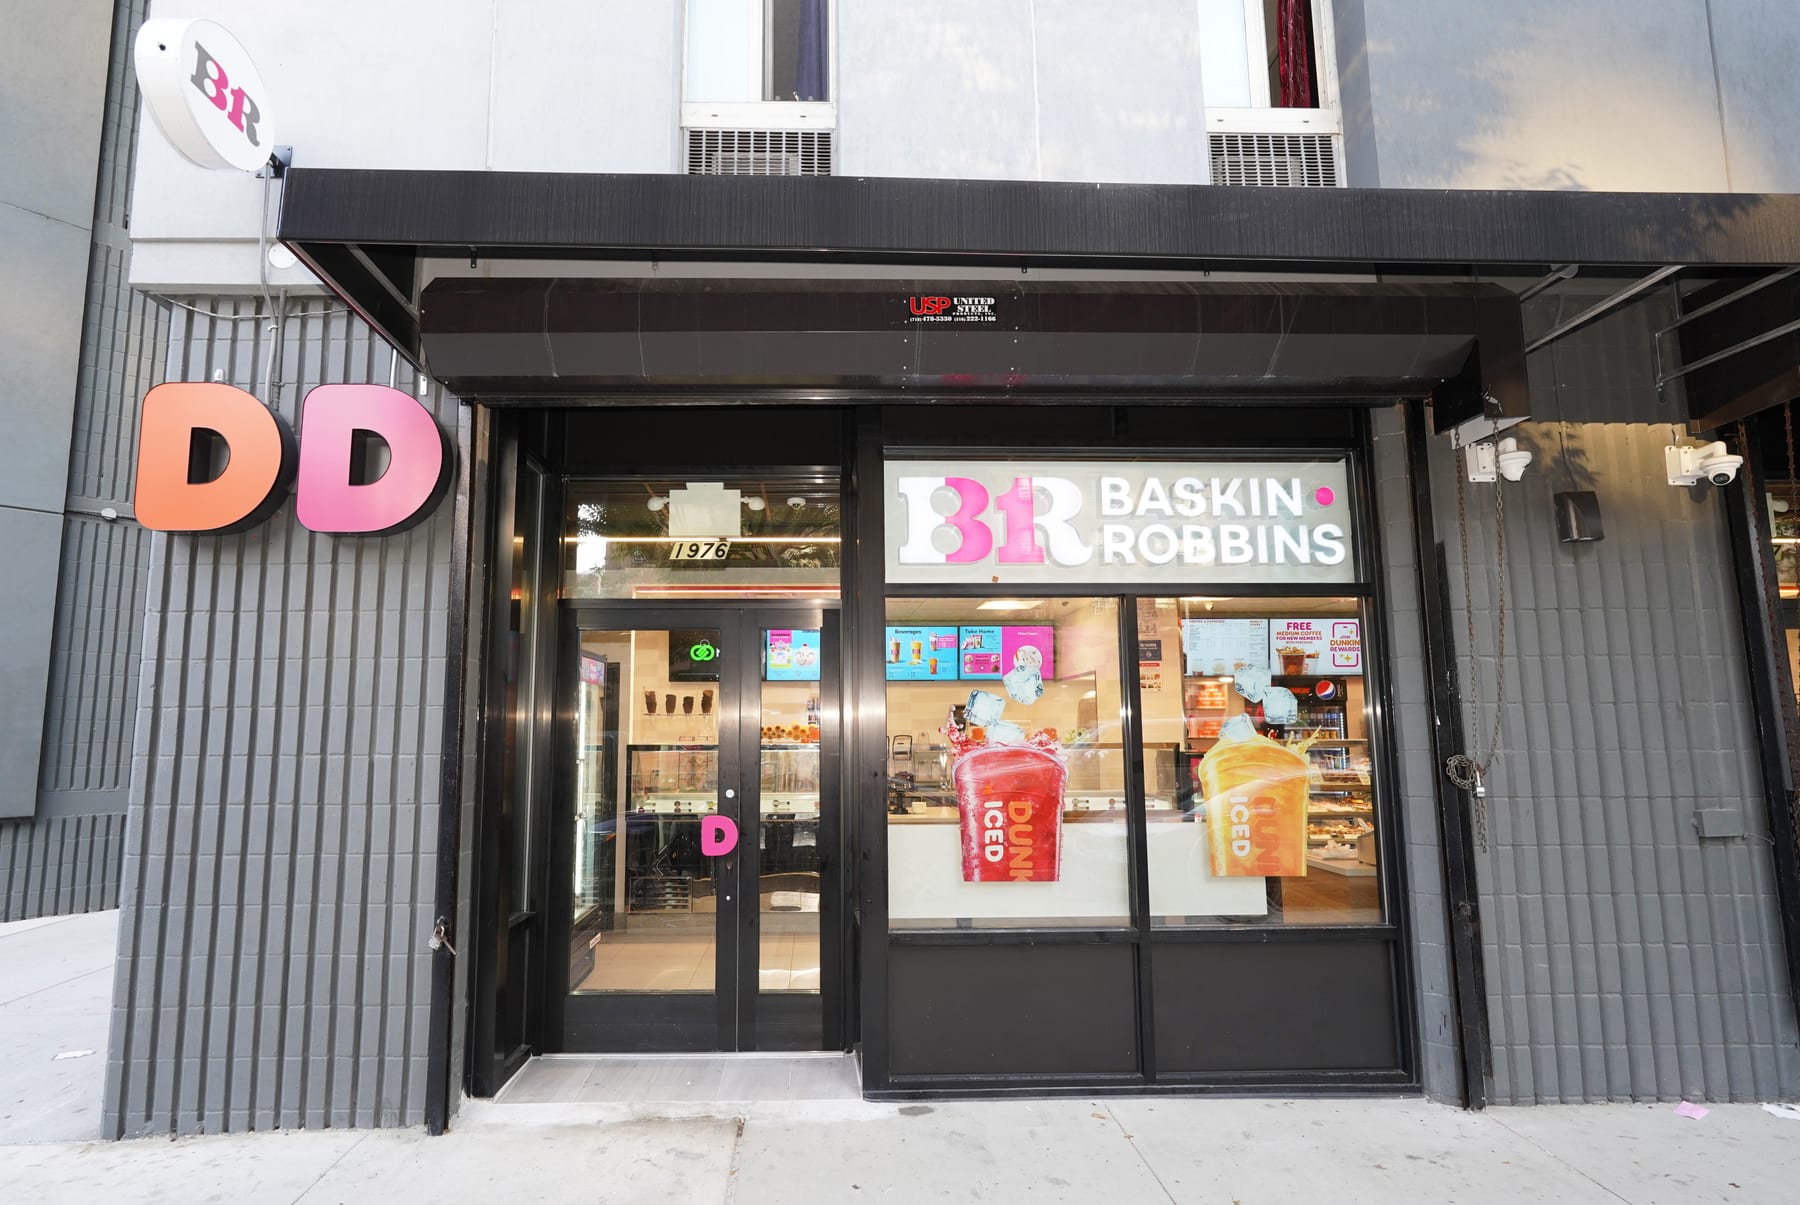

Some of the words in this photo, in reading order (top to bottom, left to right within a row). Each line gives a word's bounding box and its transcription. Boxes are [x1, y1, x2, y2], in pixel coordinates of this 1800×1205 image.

[909, 296, 952, 316] USP
[953, 297, 995, 305] UNITED
[957, 305, 992, 313] STEEL
[1101, 476, 1303, 517] BASKIN
[675, 542, 728, 559] 1976
[1102, 523, 1346, 566] ROBBINS
[1286, 622, 1312, 631] FREE
[701, 815, 739, 857] D
[984, 801, 1004, 863] ICED
[1230, 796, 1251, 857] ICED
